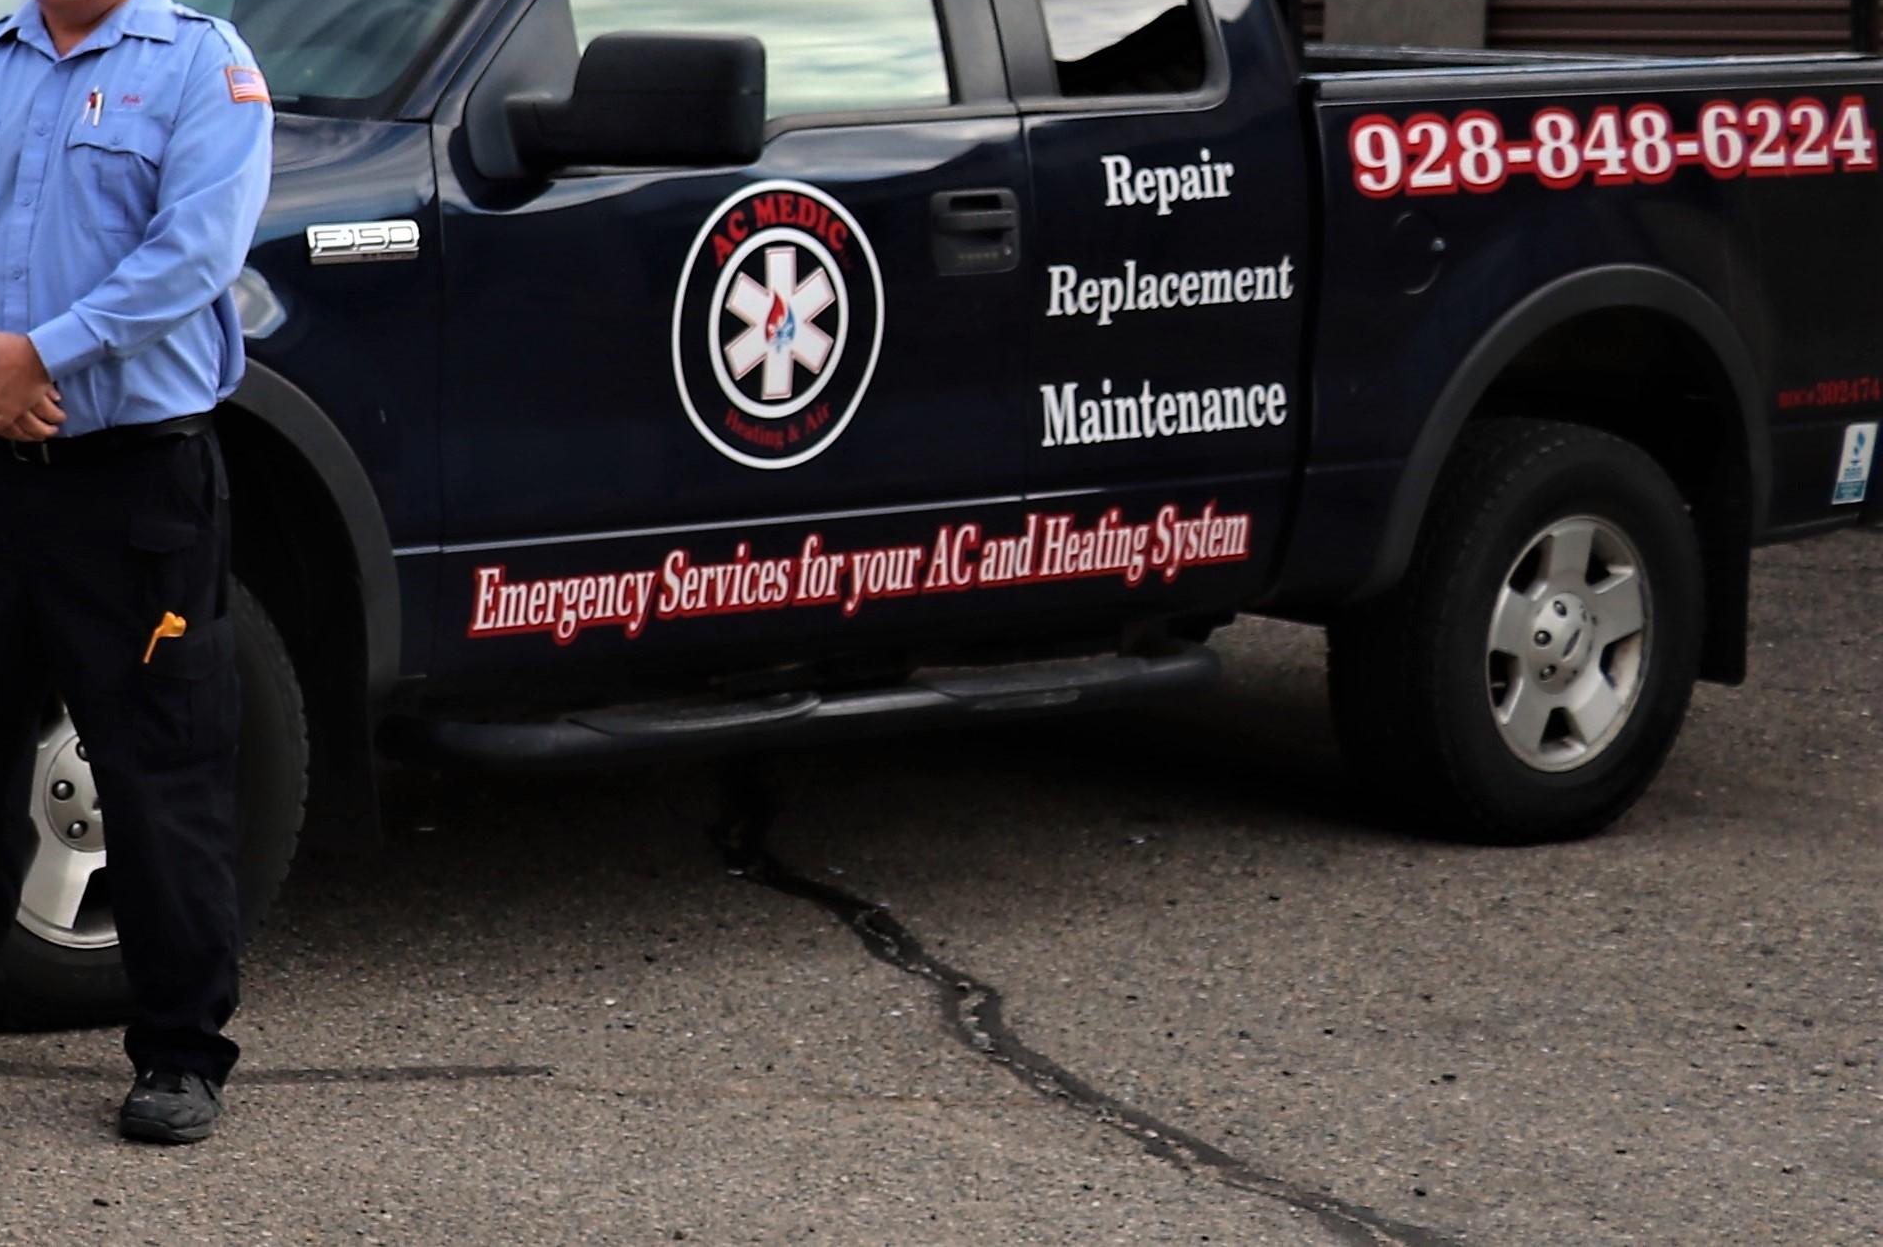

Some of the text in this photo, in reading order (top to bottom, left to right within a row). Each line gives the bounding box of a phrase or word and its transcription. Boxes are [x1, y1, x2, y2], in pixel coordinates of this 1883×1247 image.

[1100, 147, 1234, 216] Repair
[1351, 101, 1875, 195] 928-848-6224
[712, 192, 848, 268] AC MEDIC
[1045, 254, 1294, 326] Replacement
[724, 406, 784, 451] Heating
[804, 402, 831, 435] Air
[1039, 378, 1287, 447] Maintenance
[471, 500, 1250, 641] Emergency Services for your AC and Heating System
